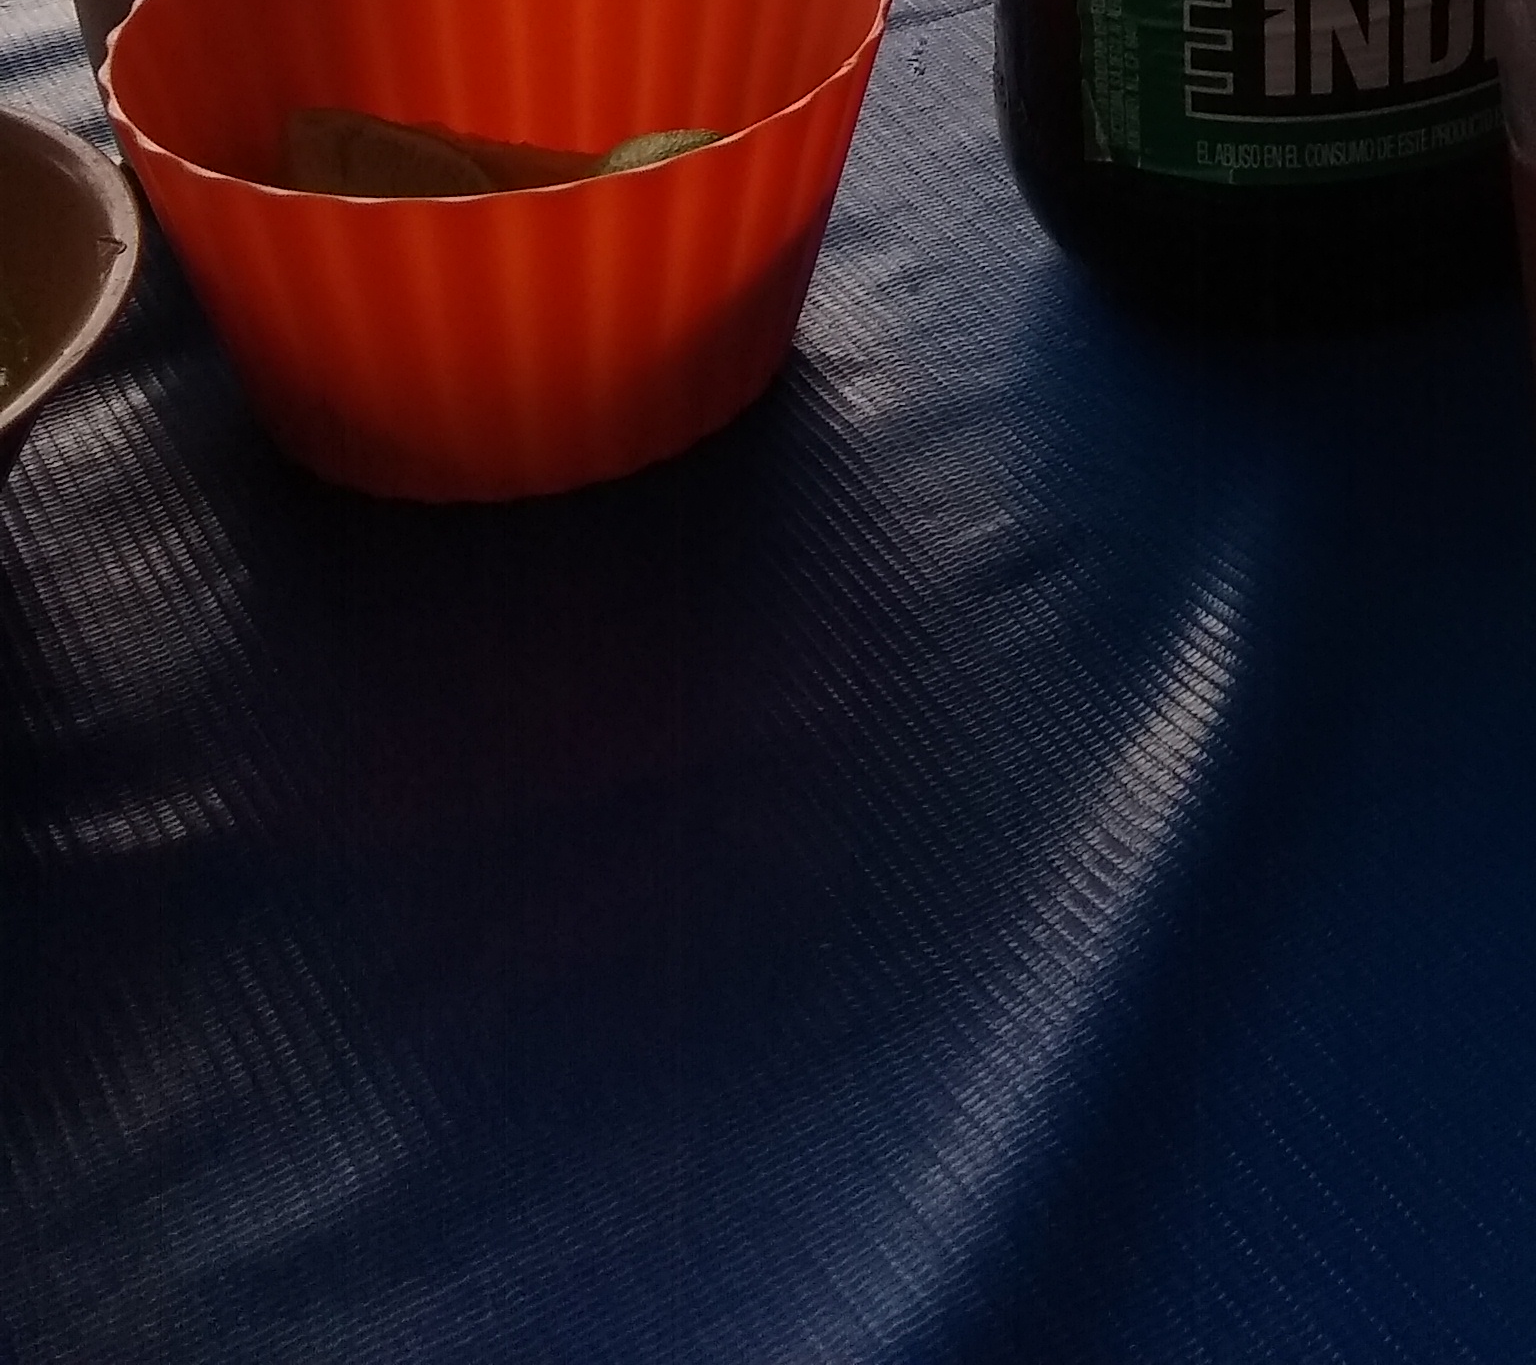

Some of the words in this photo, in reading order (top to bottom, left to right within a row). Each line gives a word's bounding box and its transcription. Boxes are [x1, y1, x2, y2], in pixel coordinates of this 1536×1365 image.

[1215, 141, 1261, 169] ABUSO
[1263, 143, 1283, 168] EN
[1304, 137, 1374, 168] CONSUMO
